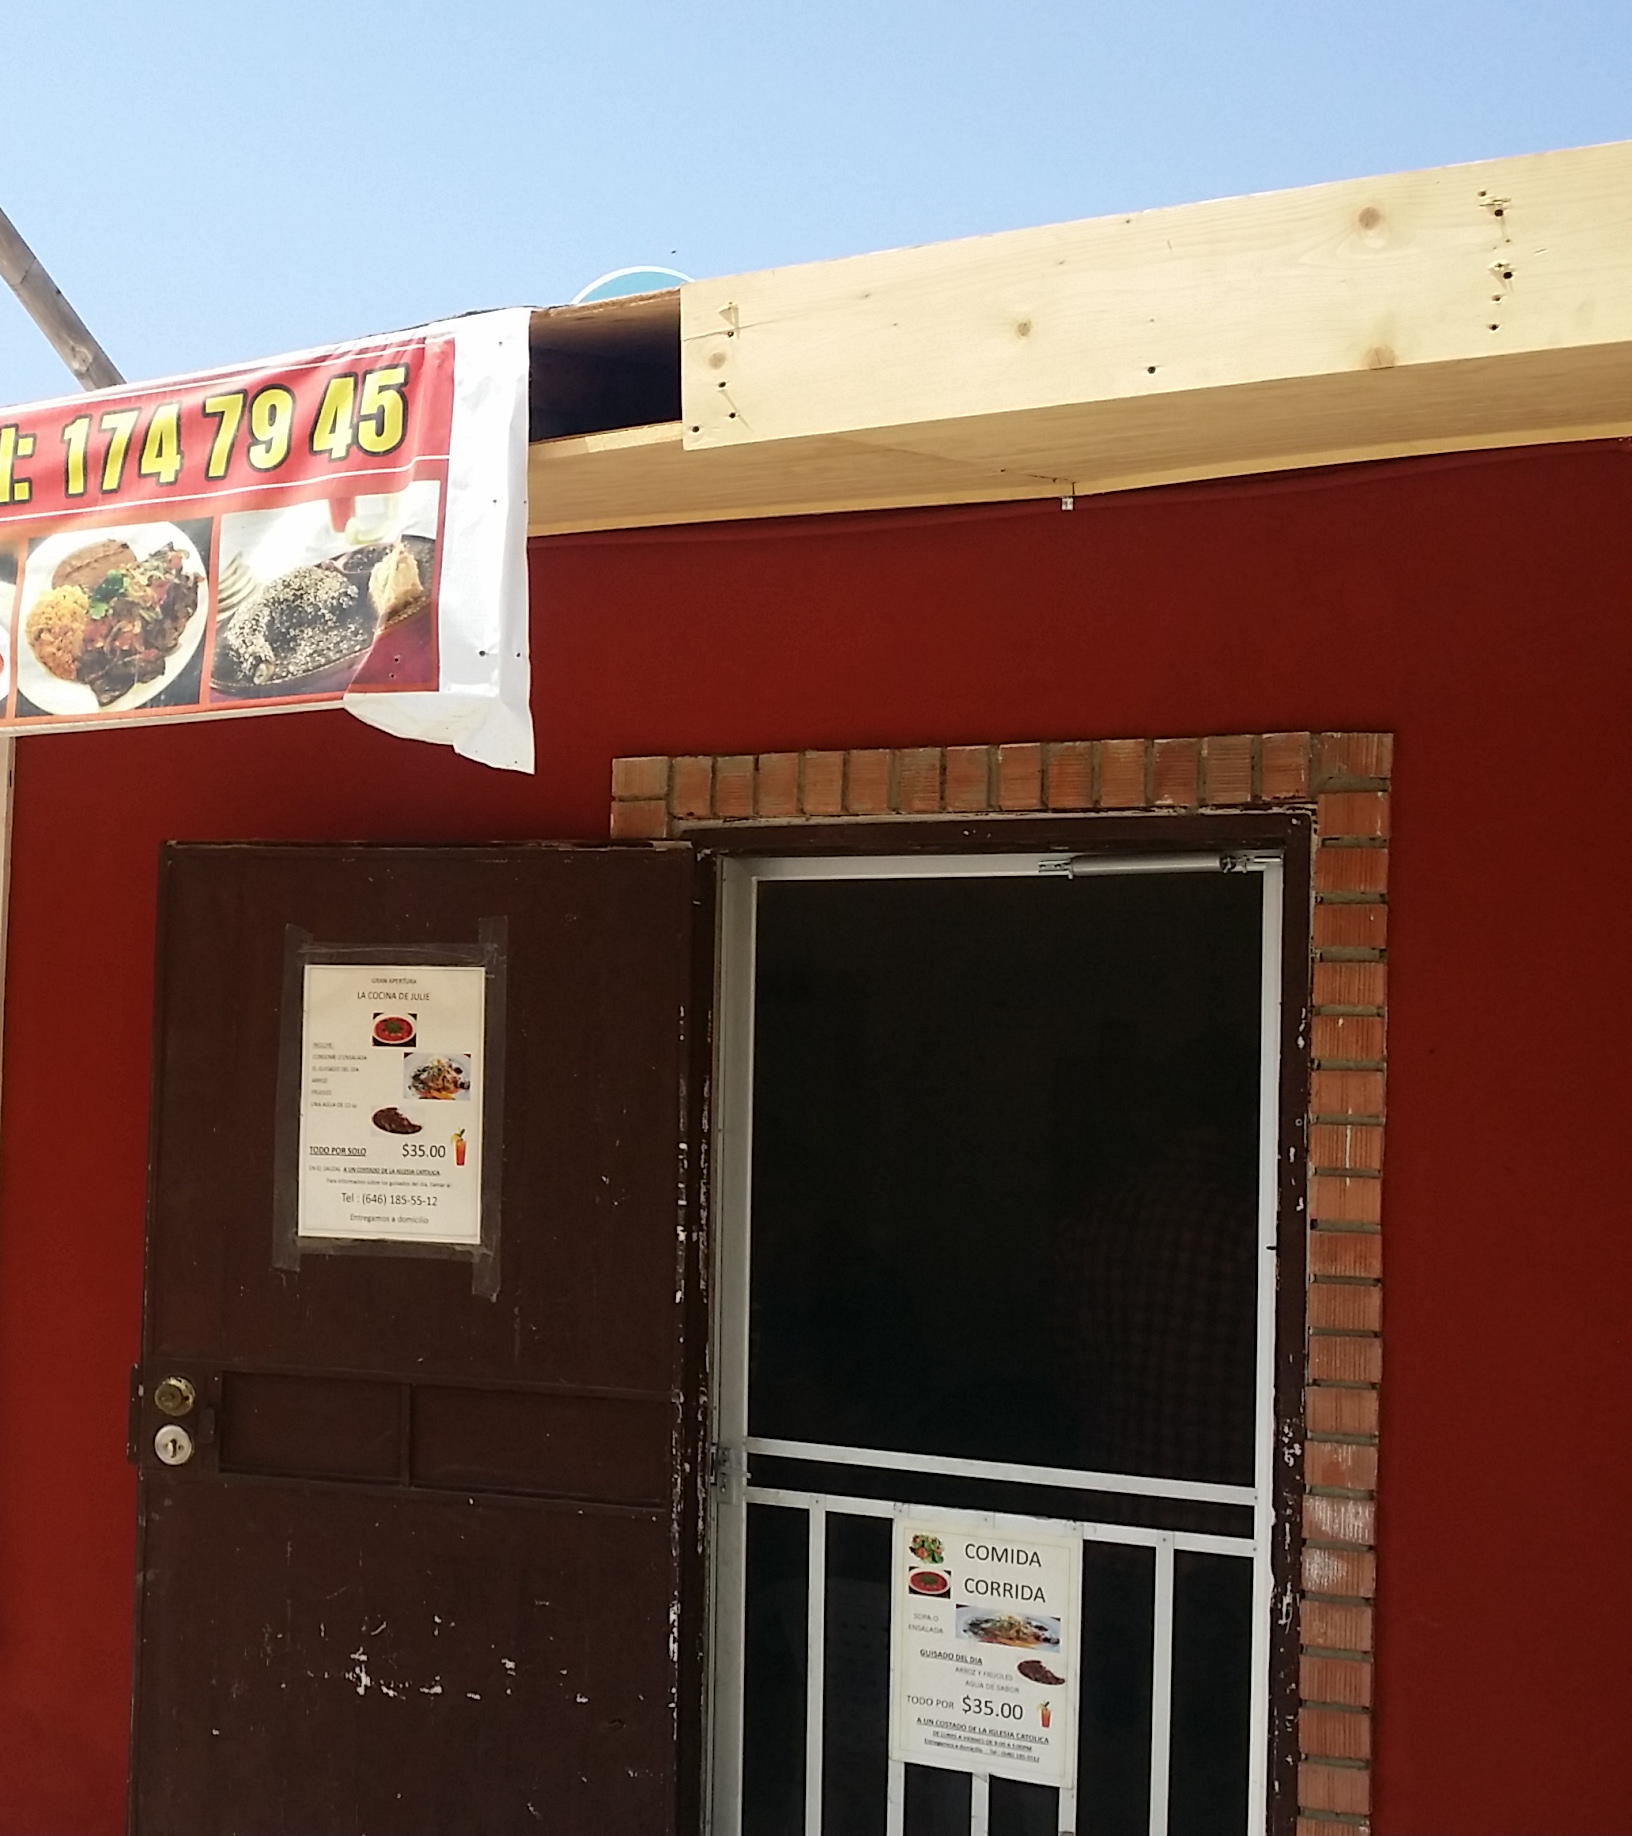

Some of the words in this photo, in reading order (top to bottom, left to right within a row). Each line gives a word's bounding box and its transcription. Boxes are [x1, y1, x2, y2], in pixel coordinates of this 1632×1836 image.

[62, 404, 185, 497] 174
[203, 385, 293, 481] 79
[310, 364, 409, 462] 45
[357, 991, 366, 1000] LA
[368, 991, 396, 1000] COCINA
[399, 992, 408, 1000] DE
[410, 992, 430, 1001] JULIE
[309, 1146, 330, 1156] TODO
[331, 1147, 346, 1156] POR
[348, 1147, 367, 1157] SOLO
[402, 1143, 446, 1158] $35.00
[362, 1193, 387, 1206] (646)
[390, 1194, 438, 1206] 185-55-12
[965, 1543, 1042, 1568] COMIDA
[964, 1577, 1046, 1603] CORRIDA
[914, 1613, 931, 1621] SOPA
[908, 1624, 943, 1634] ENSALADA
[920, 1649, 954, 1660] GUISADO
[956, 1654, 968, 1662] DEL
[970, 1656, 983, 1666] DIA
[966, 1680, 985, 1690] AGUA
[986, 1683, 995, 1691] DE
[906, 1695, 933, 1707] TODO
[935, 1700, 954, 1710] POR
[962, 1695, 1023, 1720] $35.00
